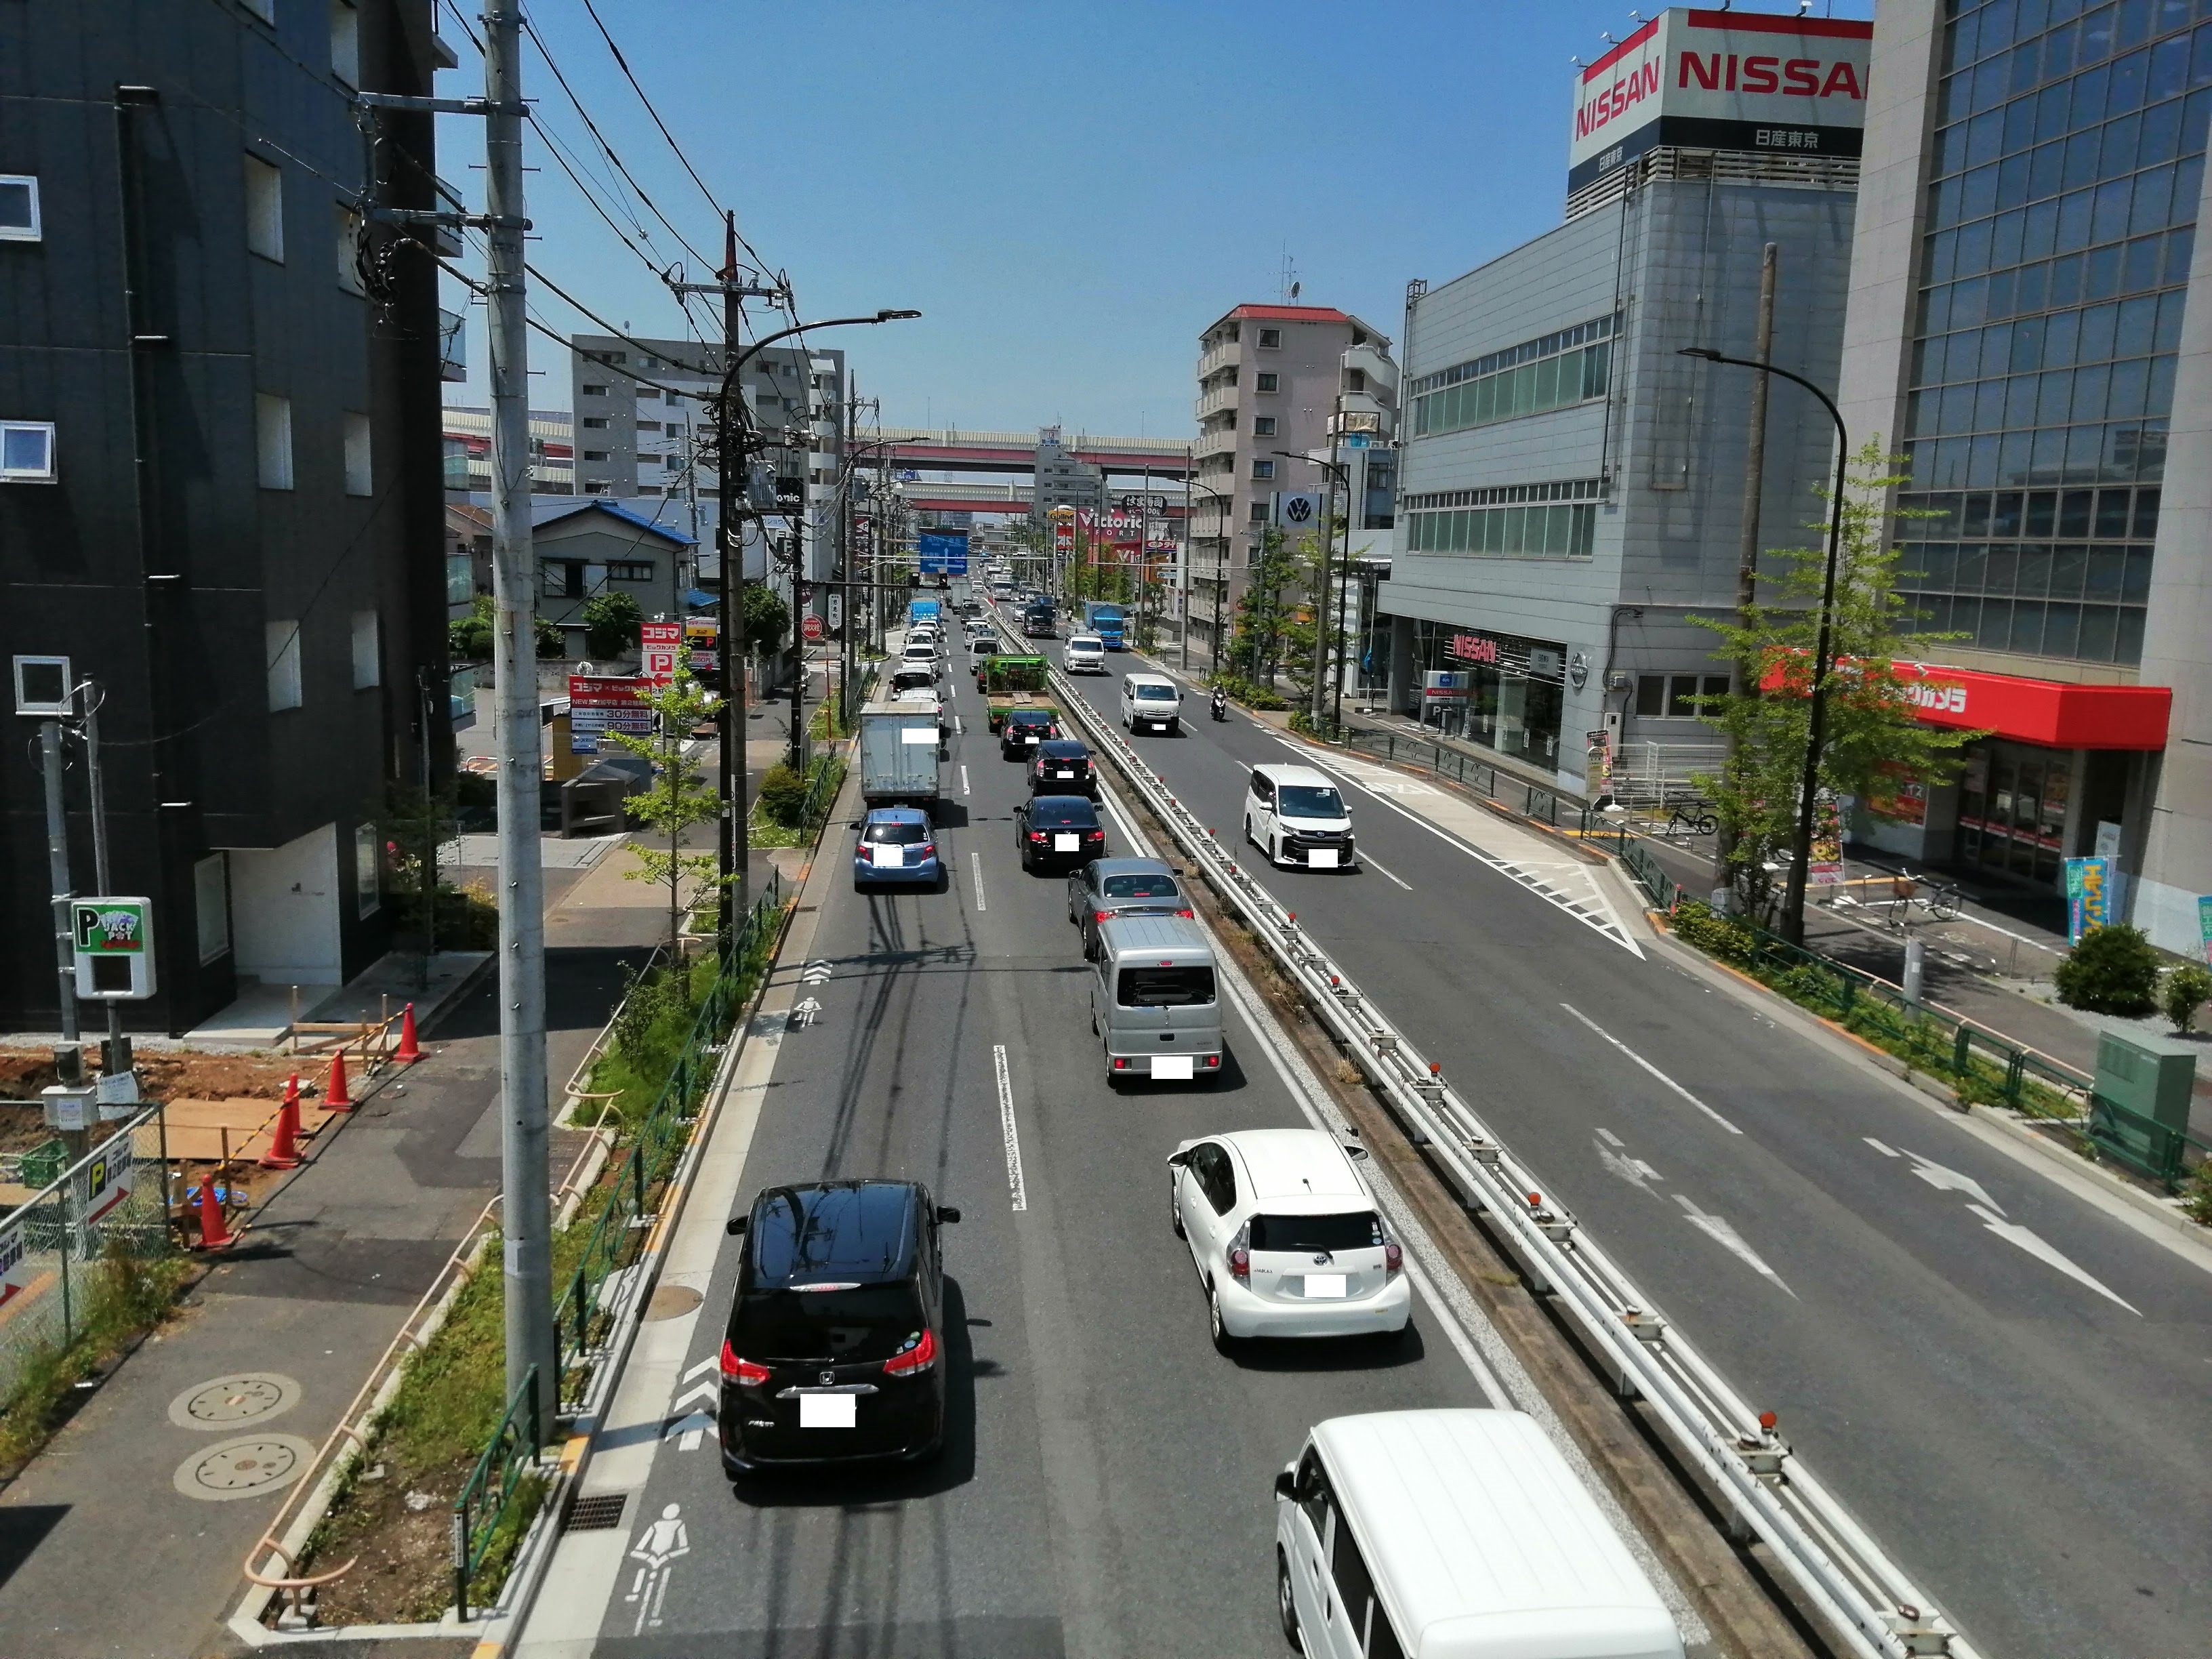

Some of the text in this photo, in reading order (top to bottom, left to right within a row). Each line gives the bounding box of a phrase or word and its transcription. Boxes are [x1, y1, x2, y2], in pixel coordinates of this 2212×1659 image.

[1678, 51, 1870, 100] NISSA
[1576, 56, 1661, 142] NISSAN
[1755, 129, 1820, 149] 日産東京
[1599, 146, 1623, 172] 日産東京
[1050, 512, 1074, 521] Gullive
[642, 627, 679, 639] コジマ
[803, 623, 821, 632] 消火栓
[706, 637, 714, 647] P
[1453, 634, 1497, 664] NISSAN
[655, 655, 670, 671] P
[607, 710, 649, 719] 30分無料
[1433, 705, 1441, 716] P
[607, 721, 649, 731] 90分無料
[77, 907, 100, 947] P
[103, 921, 134, 932] JACK
[91, 1161, 105, 1197] P
